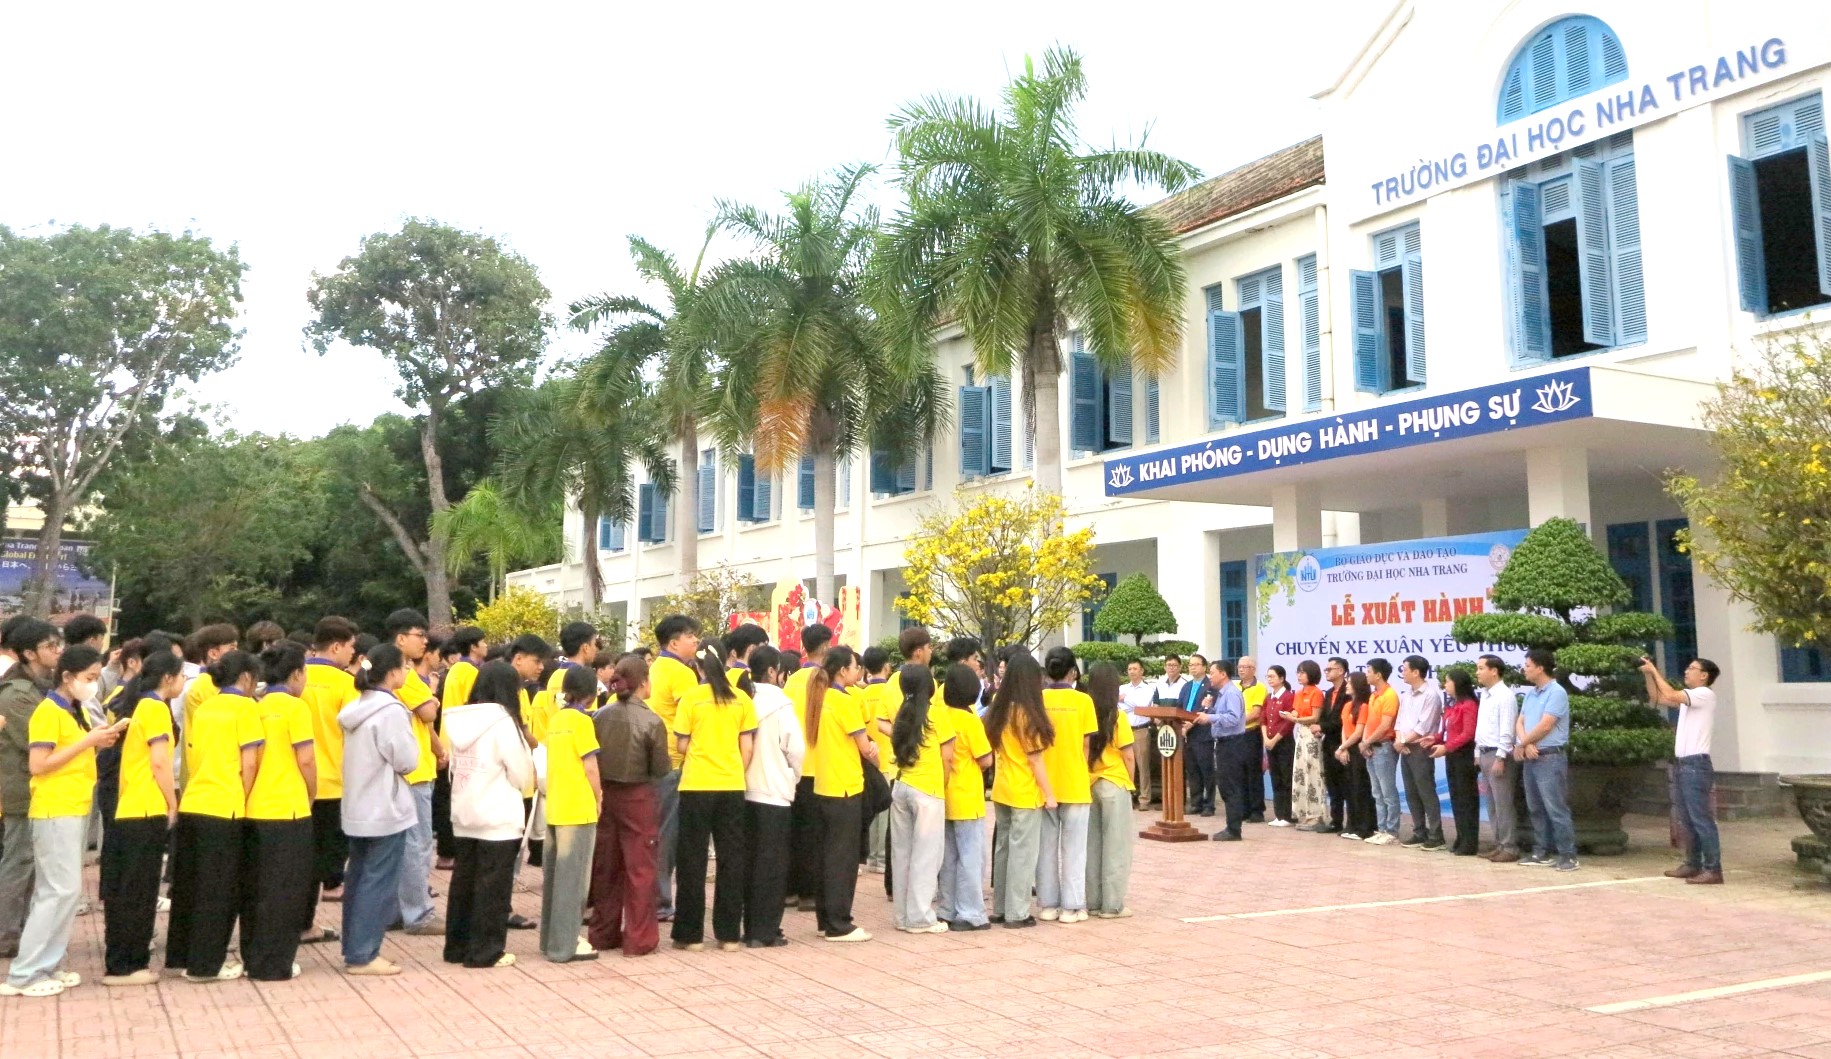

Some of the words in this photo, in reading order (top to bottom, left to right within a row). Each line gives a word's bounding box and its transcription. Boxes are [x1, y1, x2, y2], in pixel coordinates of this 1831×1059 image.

[1372, 152, 1468, 206] TRƯỜNG
[1477, 133, 1519, 170] ĐẠI
[1528, 109, 1586, 152] HỌC
[1597, 85, 1660, 128] NHA
[1667, 37, 1788, 101] TRANG
[1139, 457, 1177, 482] KHAI
[1181, 441, 1243, 475] PHÓNG
[1258, 432, 1312, 465] DỤNG
[1319, 417, 1379, 450] HÀNH
[1398, 401, 1481, 438] PHỤNG
[1488, 388, 1522, 425] SỰ
[1375, 552, 1394, 564] DỤC
[1327, 569, 1364, 583] TRƯỜNG
[1366, 569, 1383, 582] ĐẠI
[1385, 567, 1406, 580] HỌC
[1408, 566, 1430, 577] NHA
[1432, 563, 1468, 576] TRANG
[1331, 593, 1356, 627] LỄ
[1361, 592, 1416, 626] XUẤT
[1422, 591, 1484, 623] HÀNH
[1275, 635, 1341, 656] CHUYẾN
[1346, 640, 1368, 654] XE
[1373, 635, 1423, 654] XUÂN
[1429, 633, 1469, 653] YÊU
